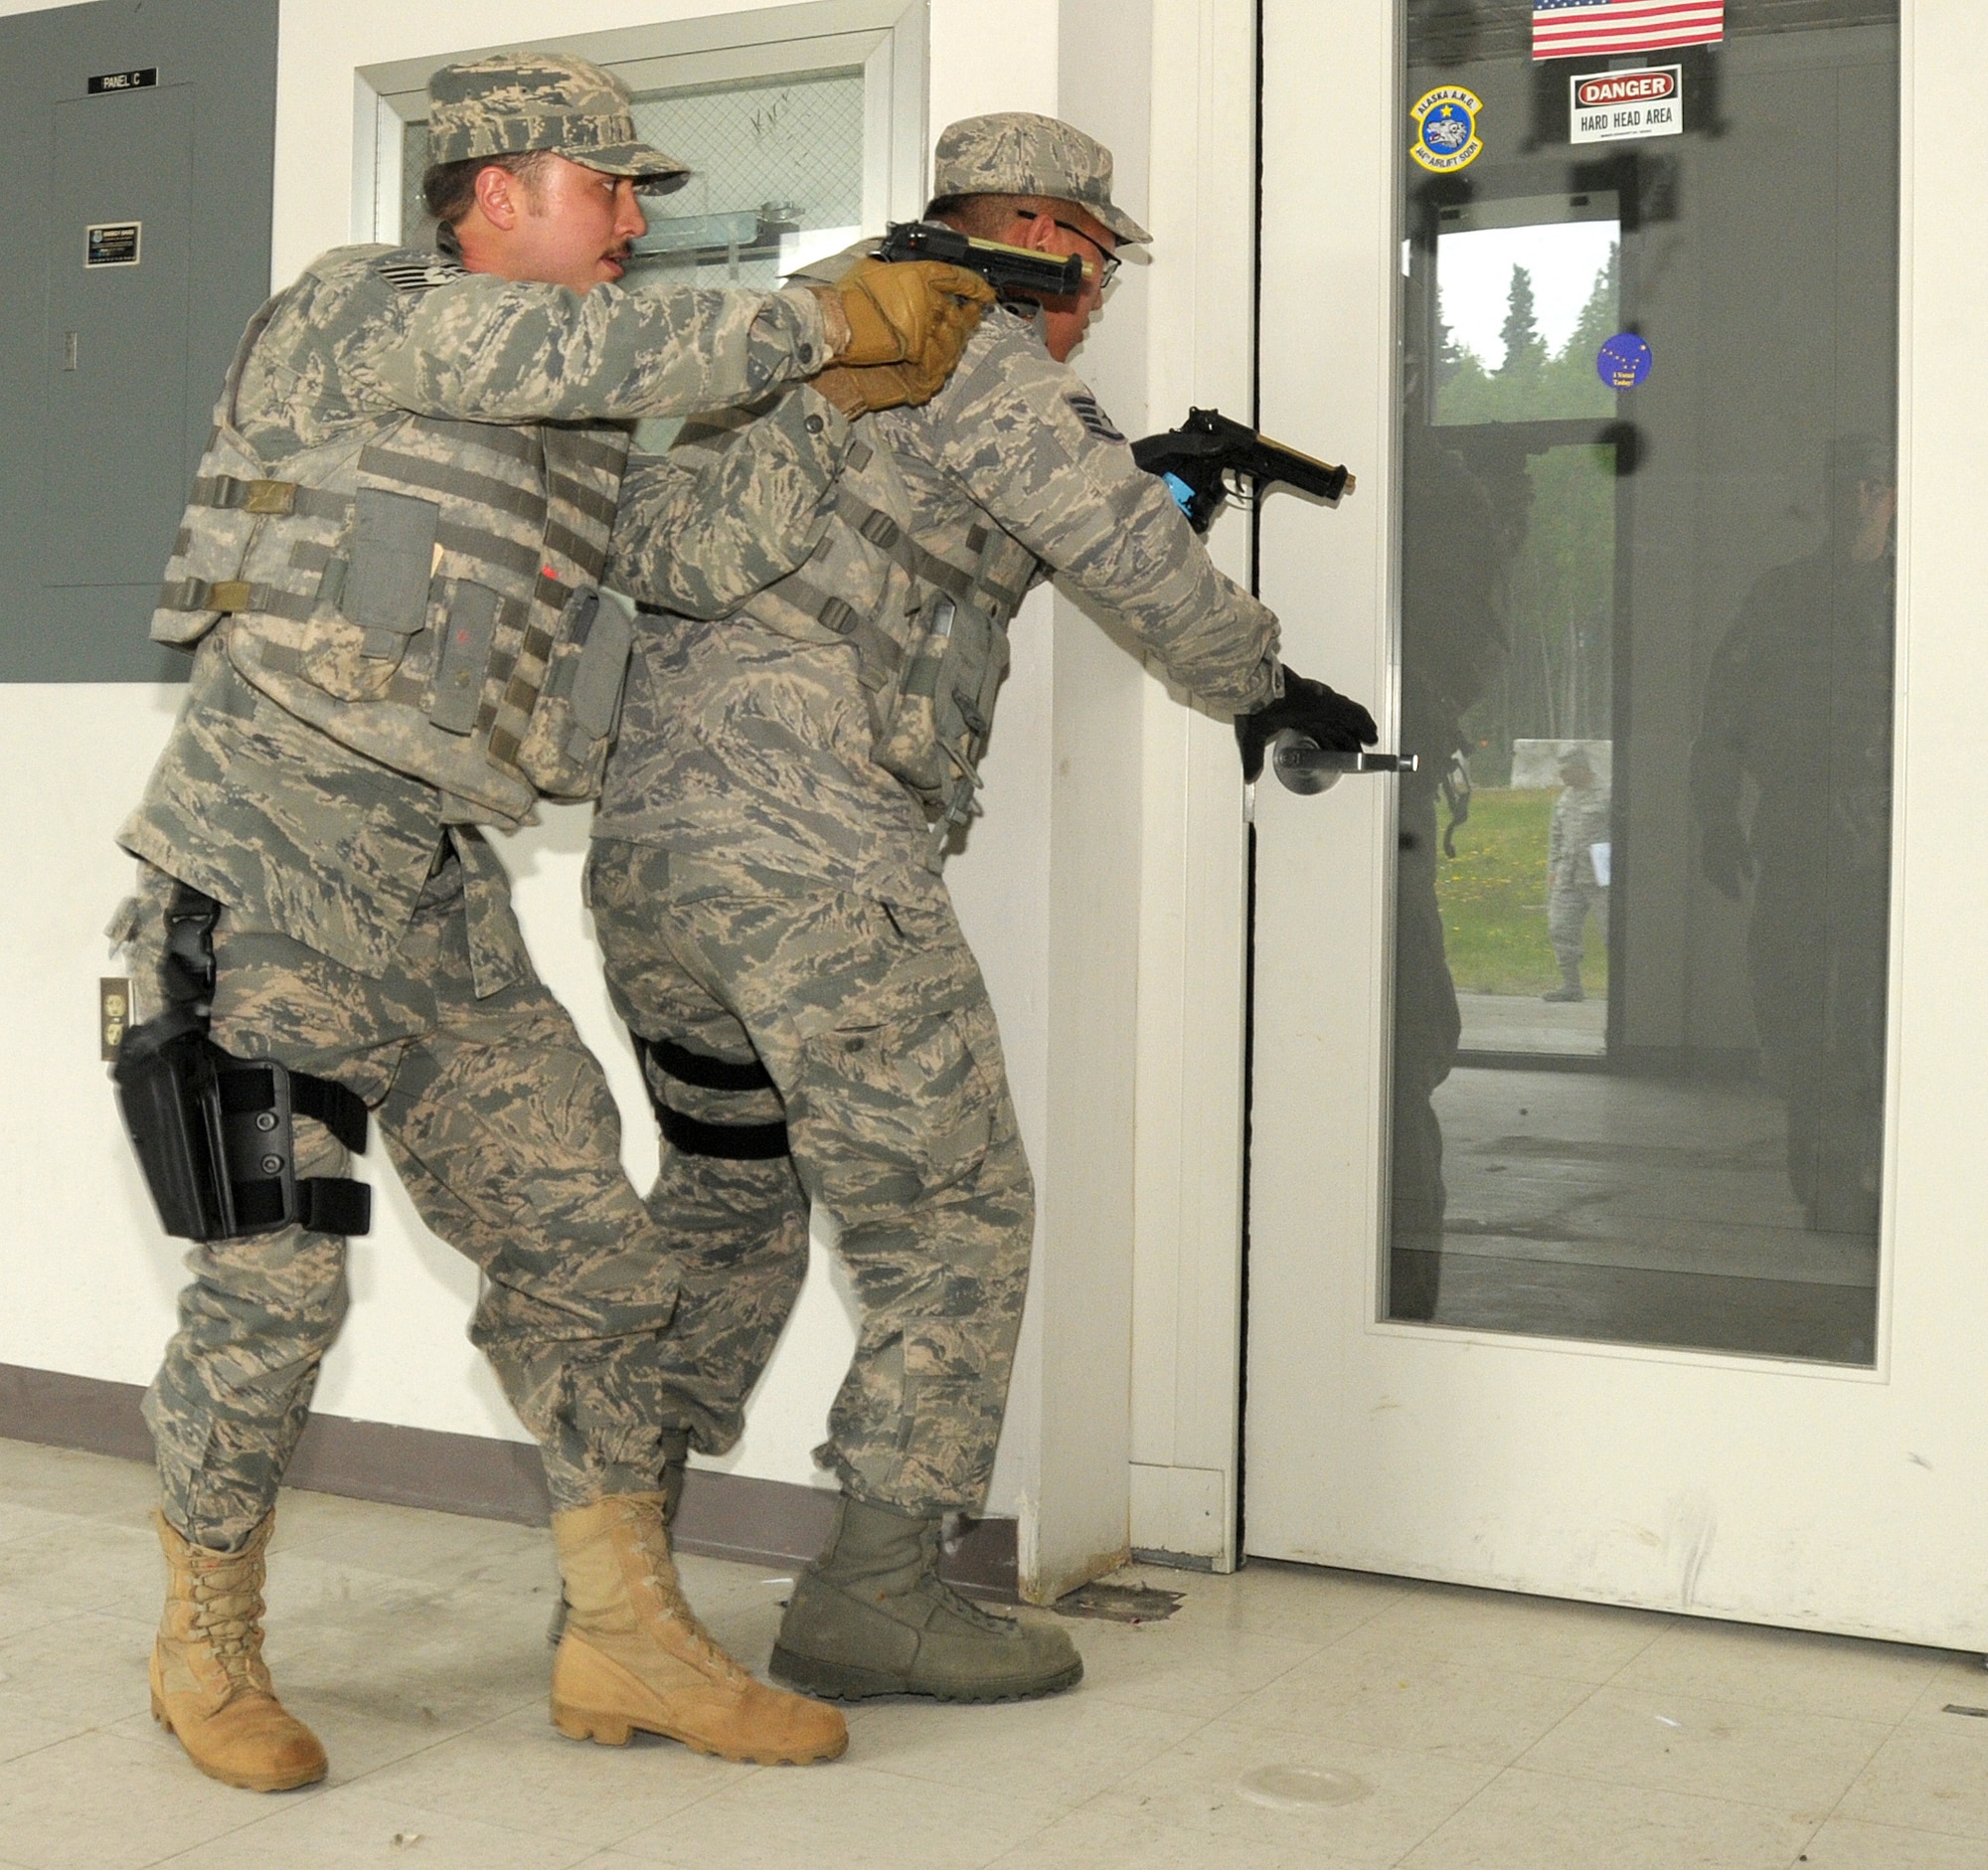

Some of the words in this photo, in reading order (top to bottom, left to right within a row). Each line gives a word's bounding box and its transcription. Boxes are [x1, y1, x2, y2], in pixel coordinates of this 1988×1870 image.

[103, 75, 130, 89] PANEL
[133, 72, 140, 85] C
[1585, 78, 1667, 101] DANGER
[1417, 90, 1449, 114] ALASKA
[1580, 114, 1608, 132] HARD
[1613, 110, 1641, 128] HEAD
[1646, 106, 1673, 125] AREA
[1428, 157, 1458, 168] AIRLIFT
